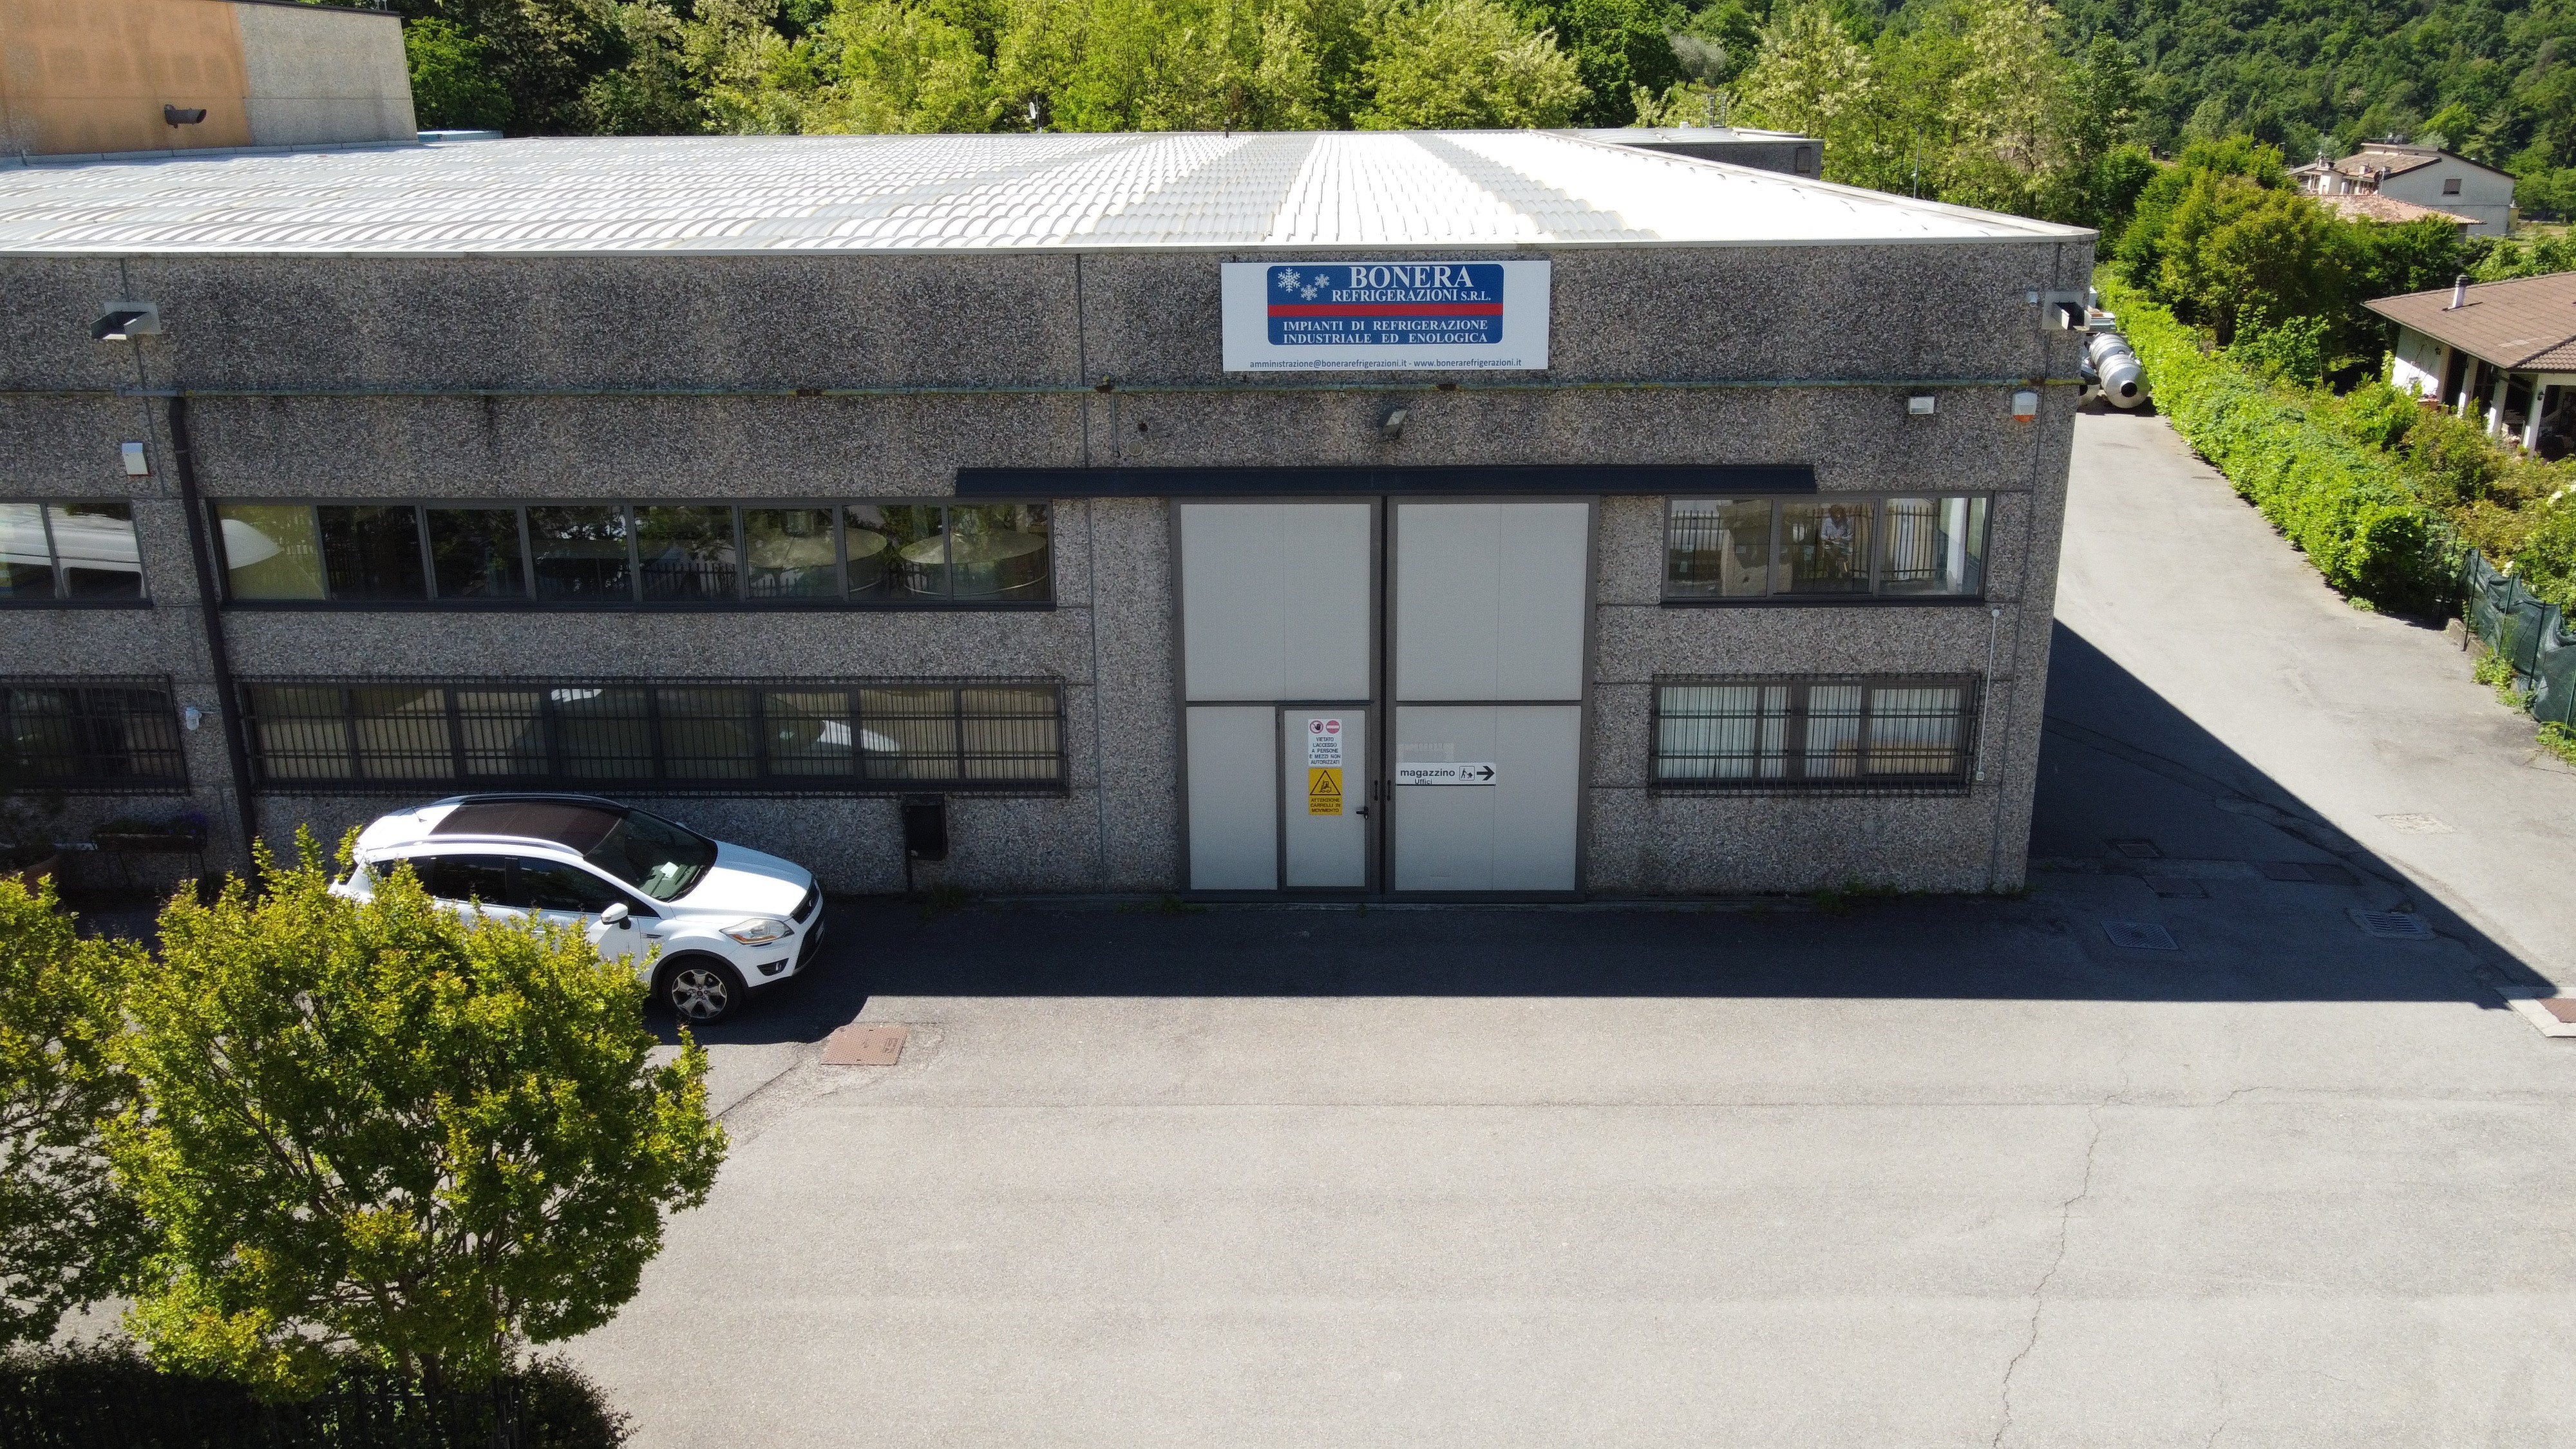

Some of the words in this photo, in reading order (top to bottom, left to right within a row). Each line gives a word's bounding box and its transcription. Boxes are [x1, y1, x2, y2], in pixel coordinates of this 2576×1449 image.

[1349, 265, 1474, 289] BONERA
[1331, 289, 1457, 302] REFRIGERAZIONI
[1461, 290, 1491, 301] S.R.L.
[1283, 321, 1343, 331] IMPIANTI
[1352, 321, 1365, 331] DI
[1373, 319, 1488, 331] REFRIGERAZIONE
[1283, 333, 1372, 344] INDUSTRIALE
[1381, 333, 1399, 343] ED
[1408, 332, 1488, 343] ENOLOGICA
[1249, 359, 1406, 369] amministrazione@bonerarefrigerazioni.it
[1414, 358, 1522, 368] www.bonerarefrigerazioni.it
[1400, 768, 1455, 778] magazzino
